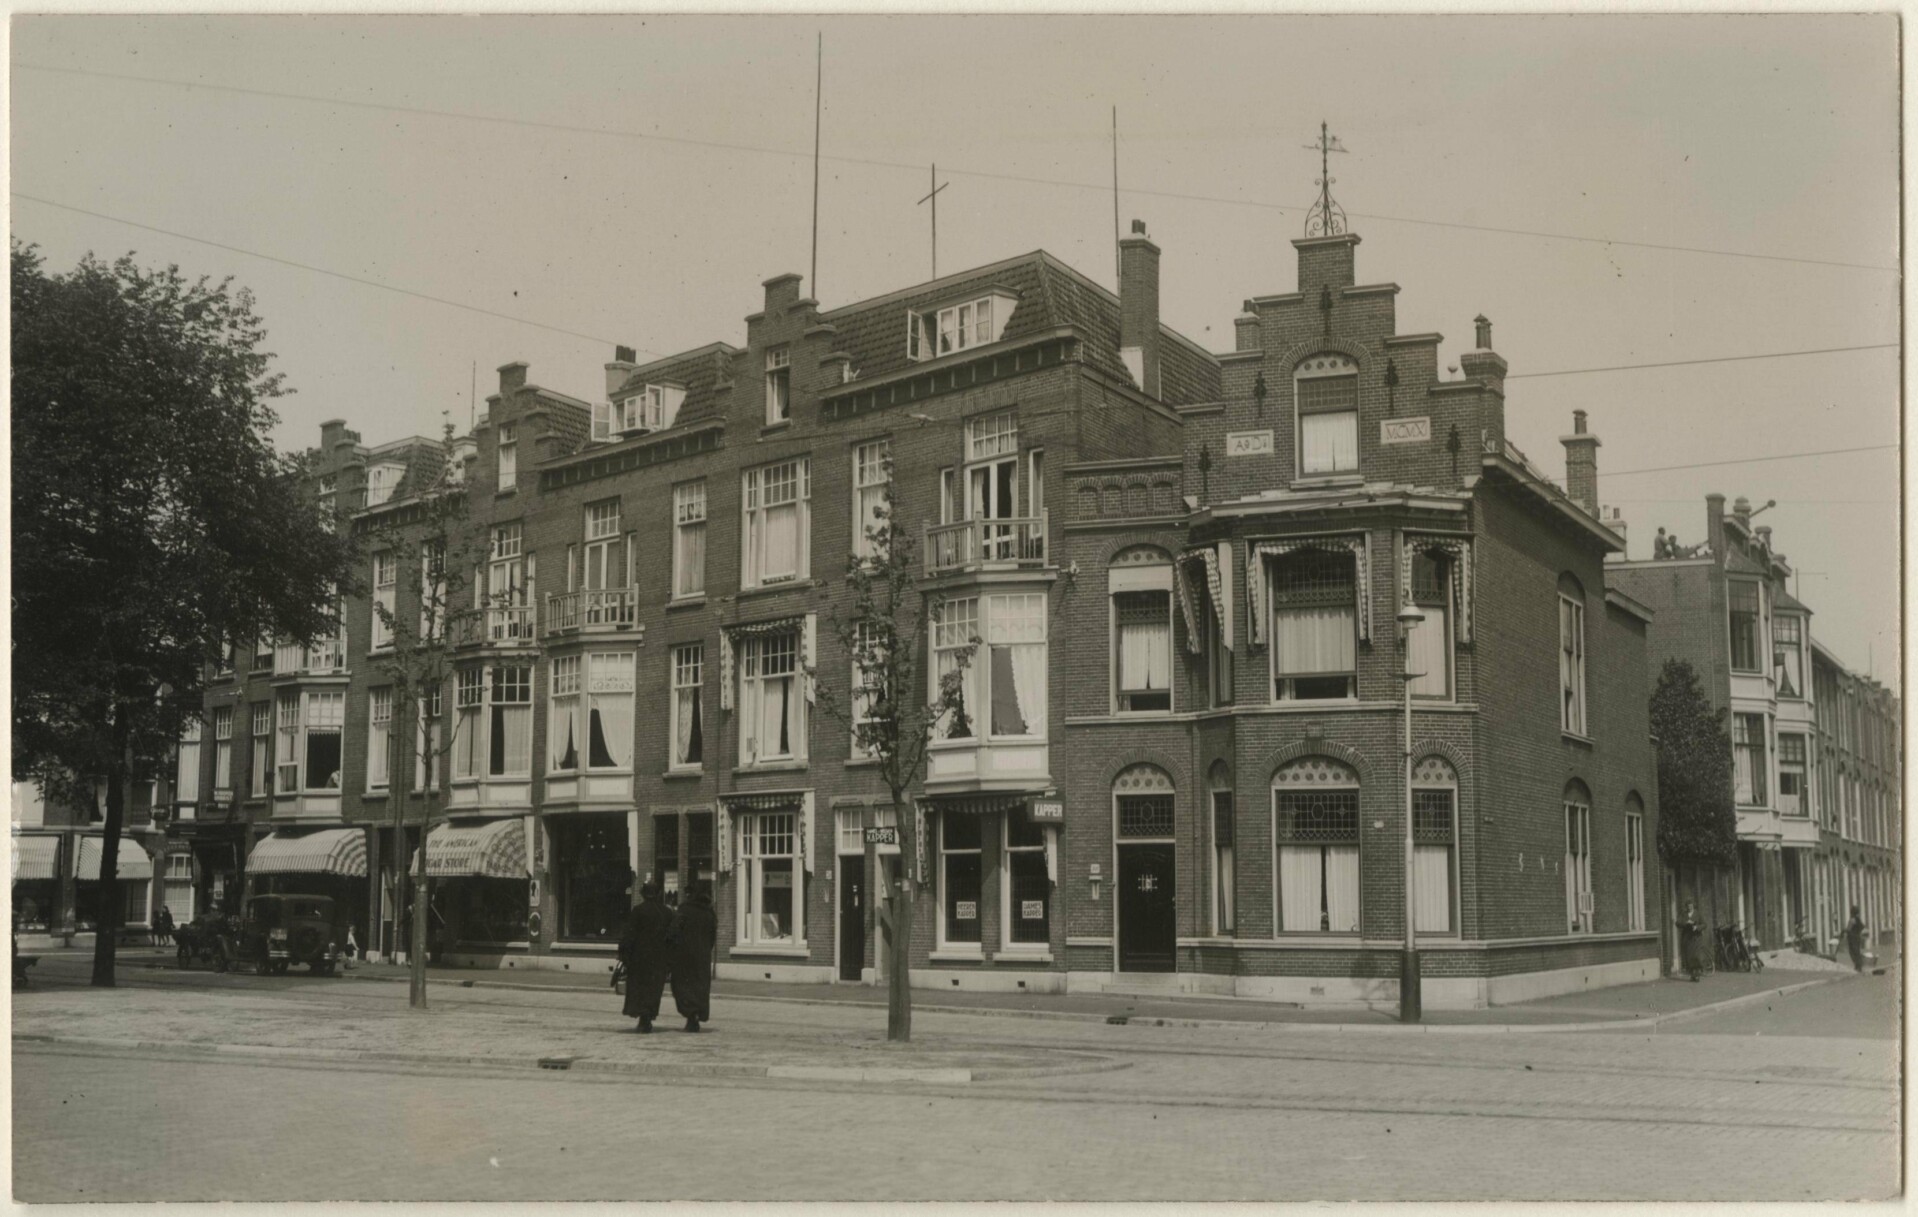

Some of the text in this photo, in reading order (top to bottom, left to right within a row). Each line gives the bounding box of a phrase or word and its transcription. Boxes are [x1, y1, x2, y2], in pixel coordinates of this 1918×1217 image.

[1034, 803, 1063, 817] KAPPER
[867, 832, 893, 843] KAPPER
[444, 858, 470, 868] STORE
